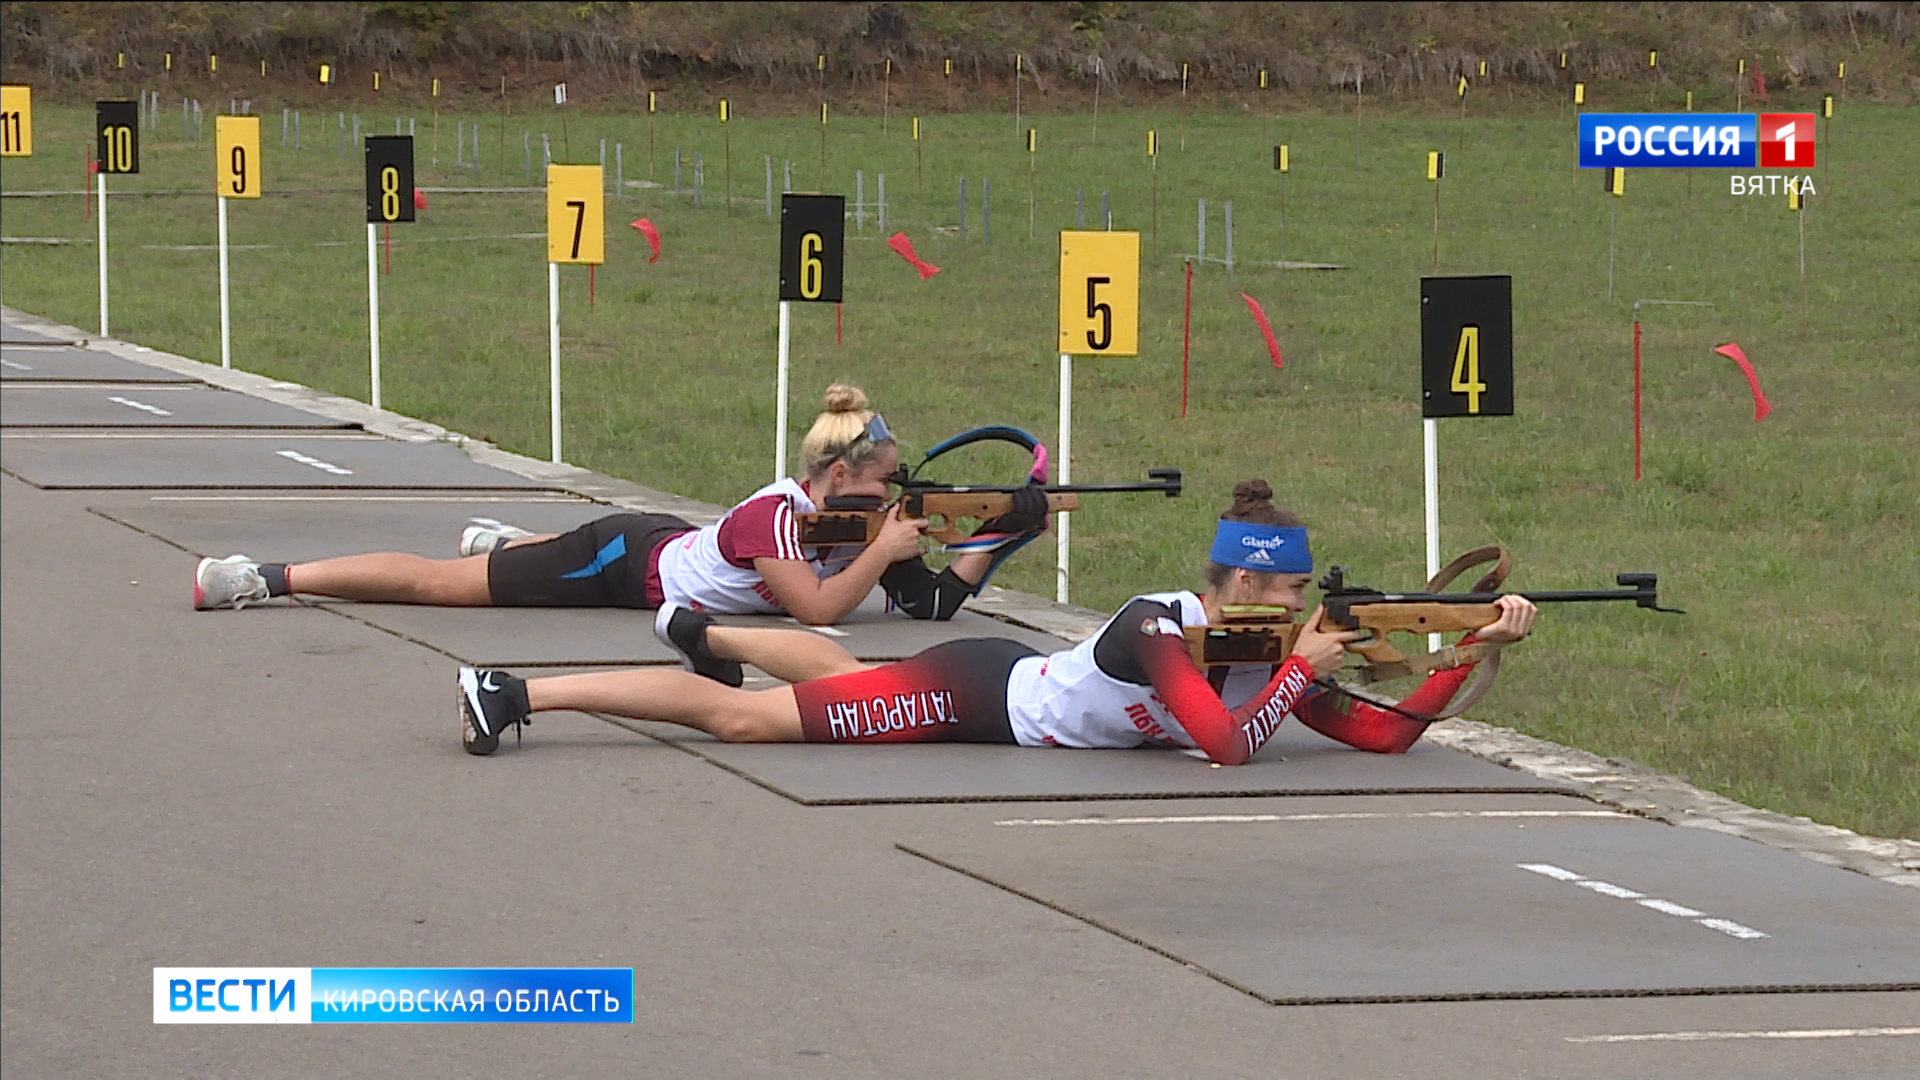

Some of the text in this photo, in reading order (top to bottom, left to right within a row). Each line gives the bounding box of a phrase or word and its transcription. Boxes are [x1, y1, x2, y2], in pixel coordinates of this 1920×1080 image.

[1, 111, 21, 152] 11
[103, 125, 132, 173] 10
[231, 145, 247, 195] 9
[380, 166, 401, 222] 8
[566, 200, 586, 259] 7
[799, 232, 824, 301] 6
[1086, 276, 1113, 351] 5
[1449, 326, 1488, 415] 4
[825, 690, 960, 741] ТАТАРСТАН
[1241, 664, 1308, 757] ТАТАРСТАН
